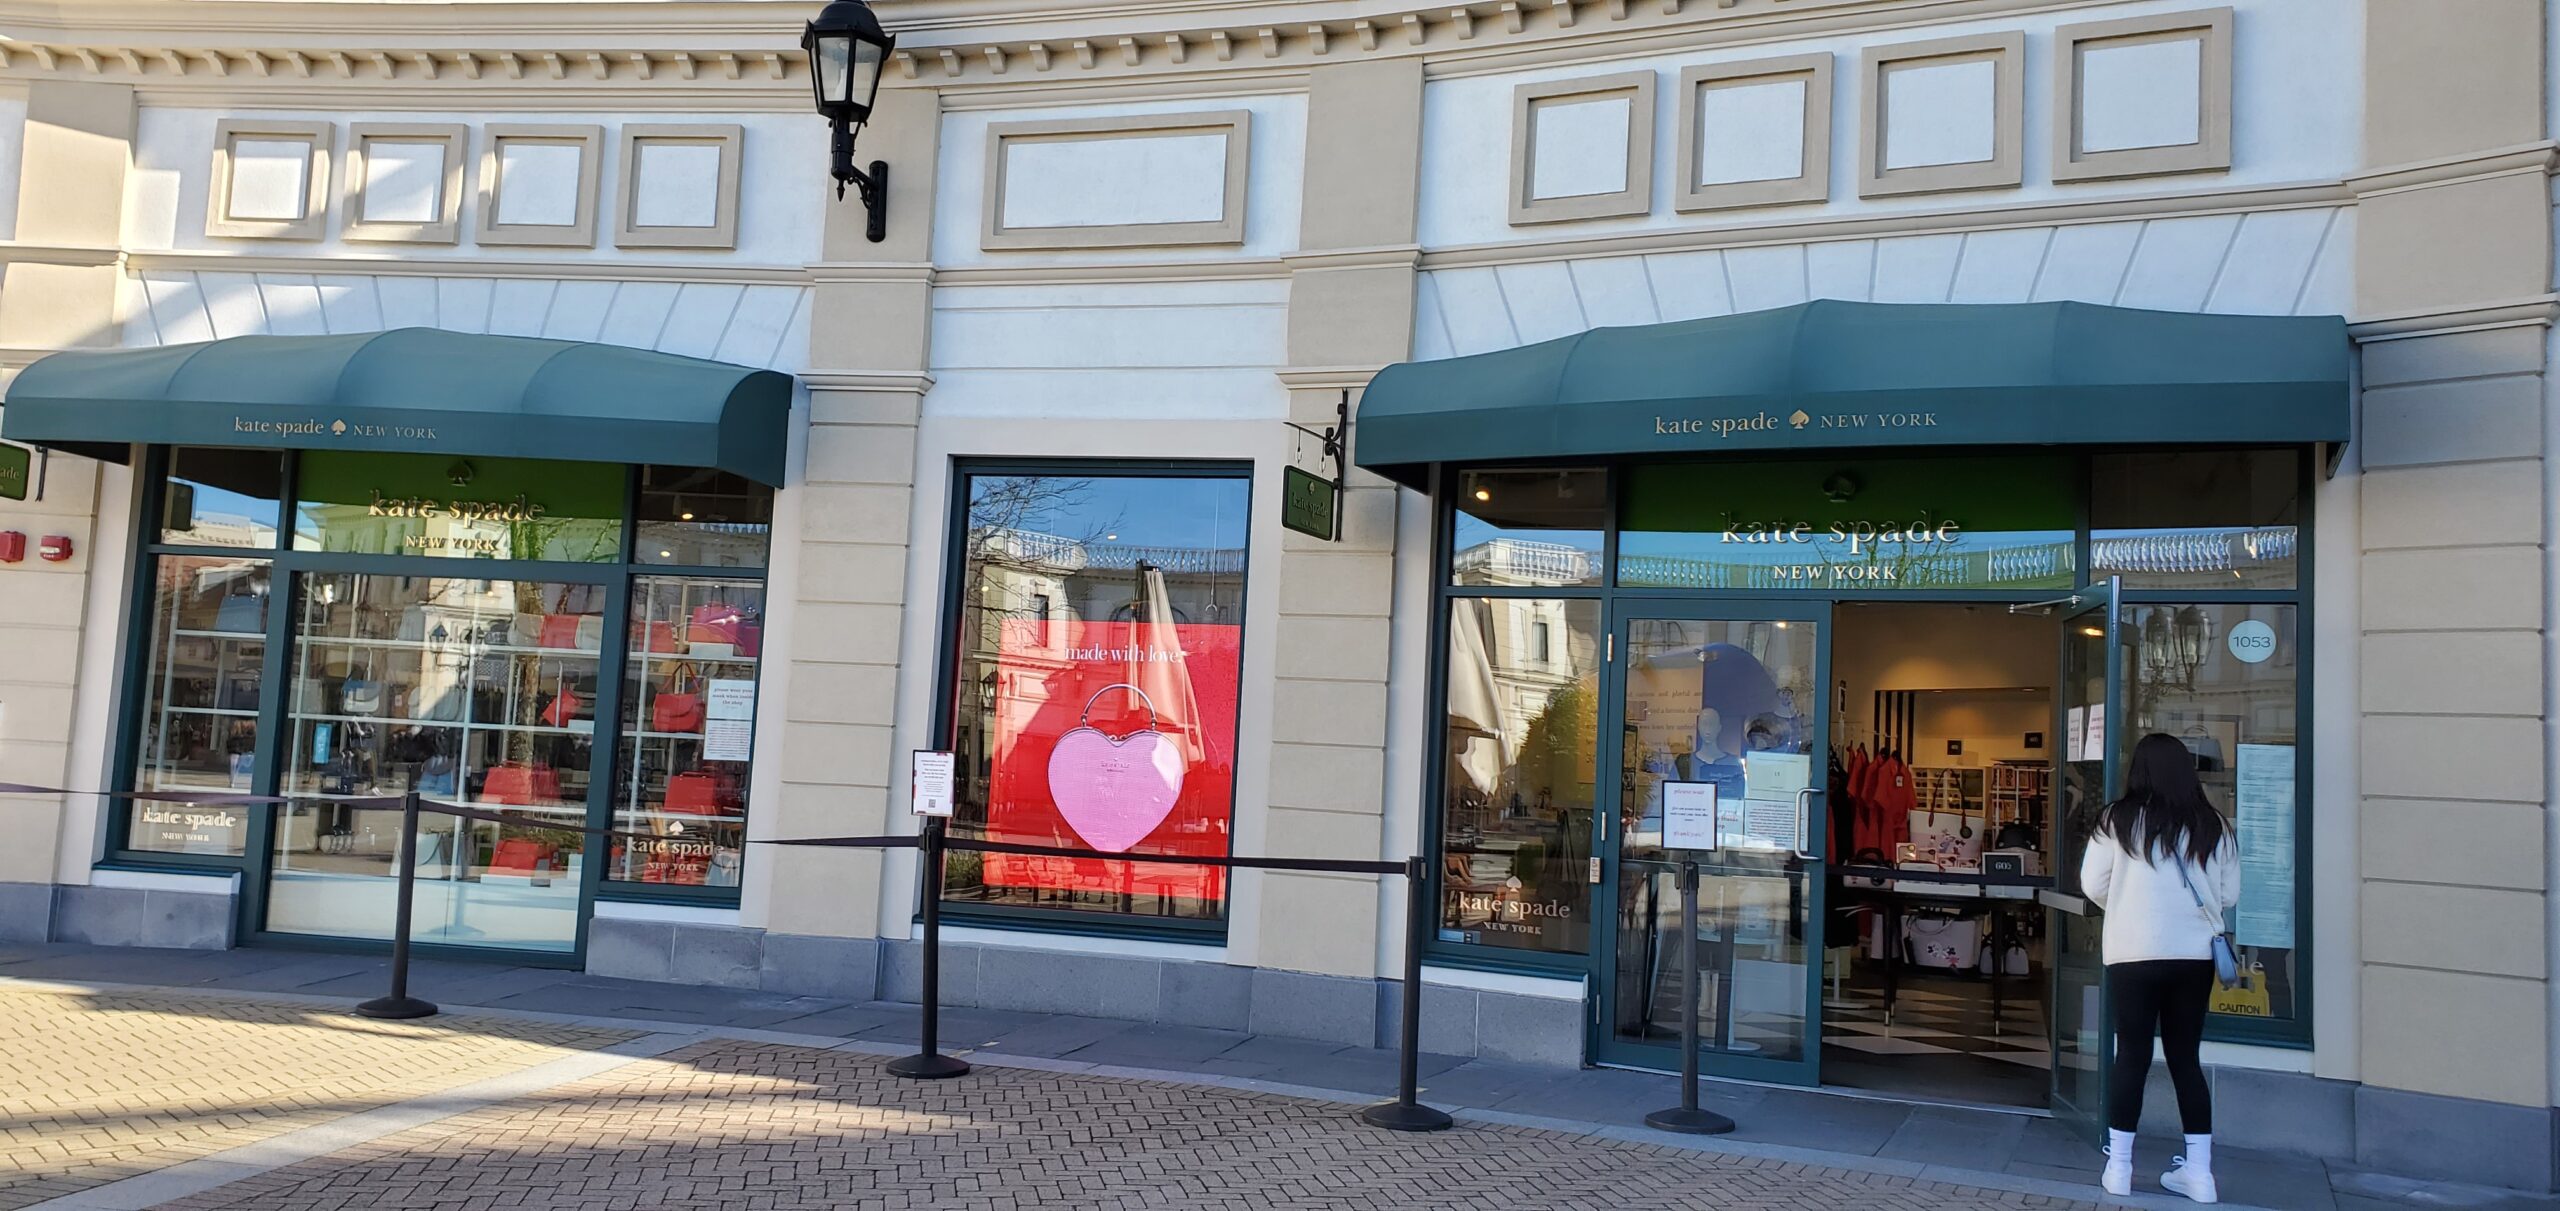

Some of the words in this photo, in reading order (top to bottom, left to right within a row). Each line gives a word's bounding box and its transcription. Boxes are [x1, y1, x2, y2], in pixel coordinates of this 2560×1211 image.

[234, 416, 270, 432] kate
[275, 419, 325, 438] spade
[353, 424, 387, 437] NEW
[394, 426, 437, 439] YORK
[1655, 416, 1702, 434] kate
[1711, 412, 1778, 438] spade
[1820, 414, 1869, 428] NEW
[1878, 412, 1938, 427] YORK
[367, 488, 440, 519] kate
[449, 493, 546, 530] spade
[1719, 511, 1813, 544] kate
[1829, 508, 1961, 556] spade
[405, 535, 445, 548] NEW
[451, 537, 498, 551] YORK
[1774, 565, 1824, 580] NEW
[1833, 565, 1898, 580] YORK
[2233, 636, 2271, 648] 1053
[1065, 643, 1108, 660] made
[1110, 645, 1144, 662] with
[142, 807, 181, 824] kate
[184, 811, 237, 830] spade
[629, 837, 668, 854] kate
[671, 840, 725, 859] spade
[648, 862, 669, 870] NEW
[672, 863, 699, 872] YORK
[1459, 891, 1502, 912] kate
[1509, 900, 1571, 920] spade
[1483, 921, 1509, 931] NEW
[1511, 924, 1542, 935] YORK
[2218, 1003, 2261, 1015] CAUTION
